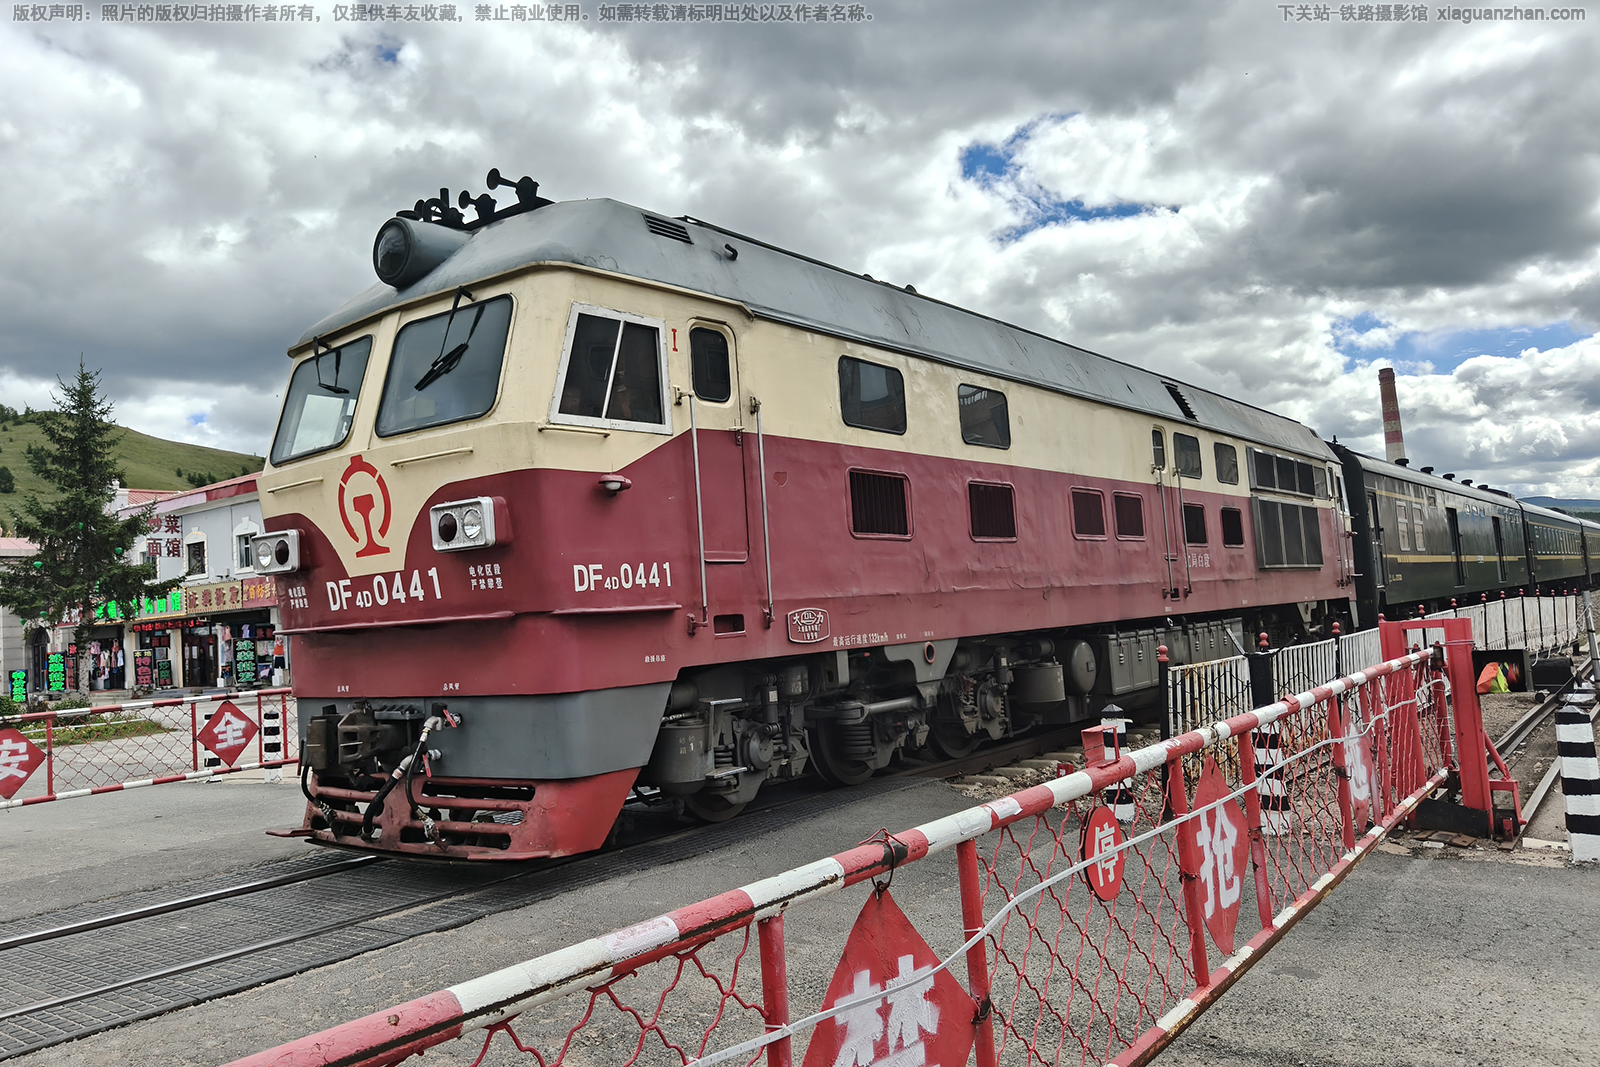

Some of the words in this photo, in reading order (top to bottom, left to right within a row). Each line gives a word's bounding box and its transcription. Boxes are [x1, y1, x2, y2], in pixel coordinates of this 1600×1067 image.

[147, 538, 181, 557] 面馆
[326, 566, 442, 612] DF4D0441
[573, 562, 672, 592] DF4D0441
[213, 711, 246, 750] 全
[1093, 822, 1119, 888] 停
[1196, 799, 1241, 920] 抢
